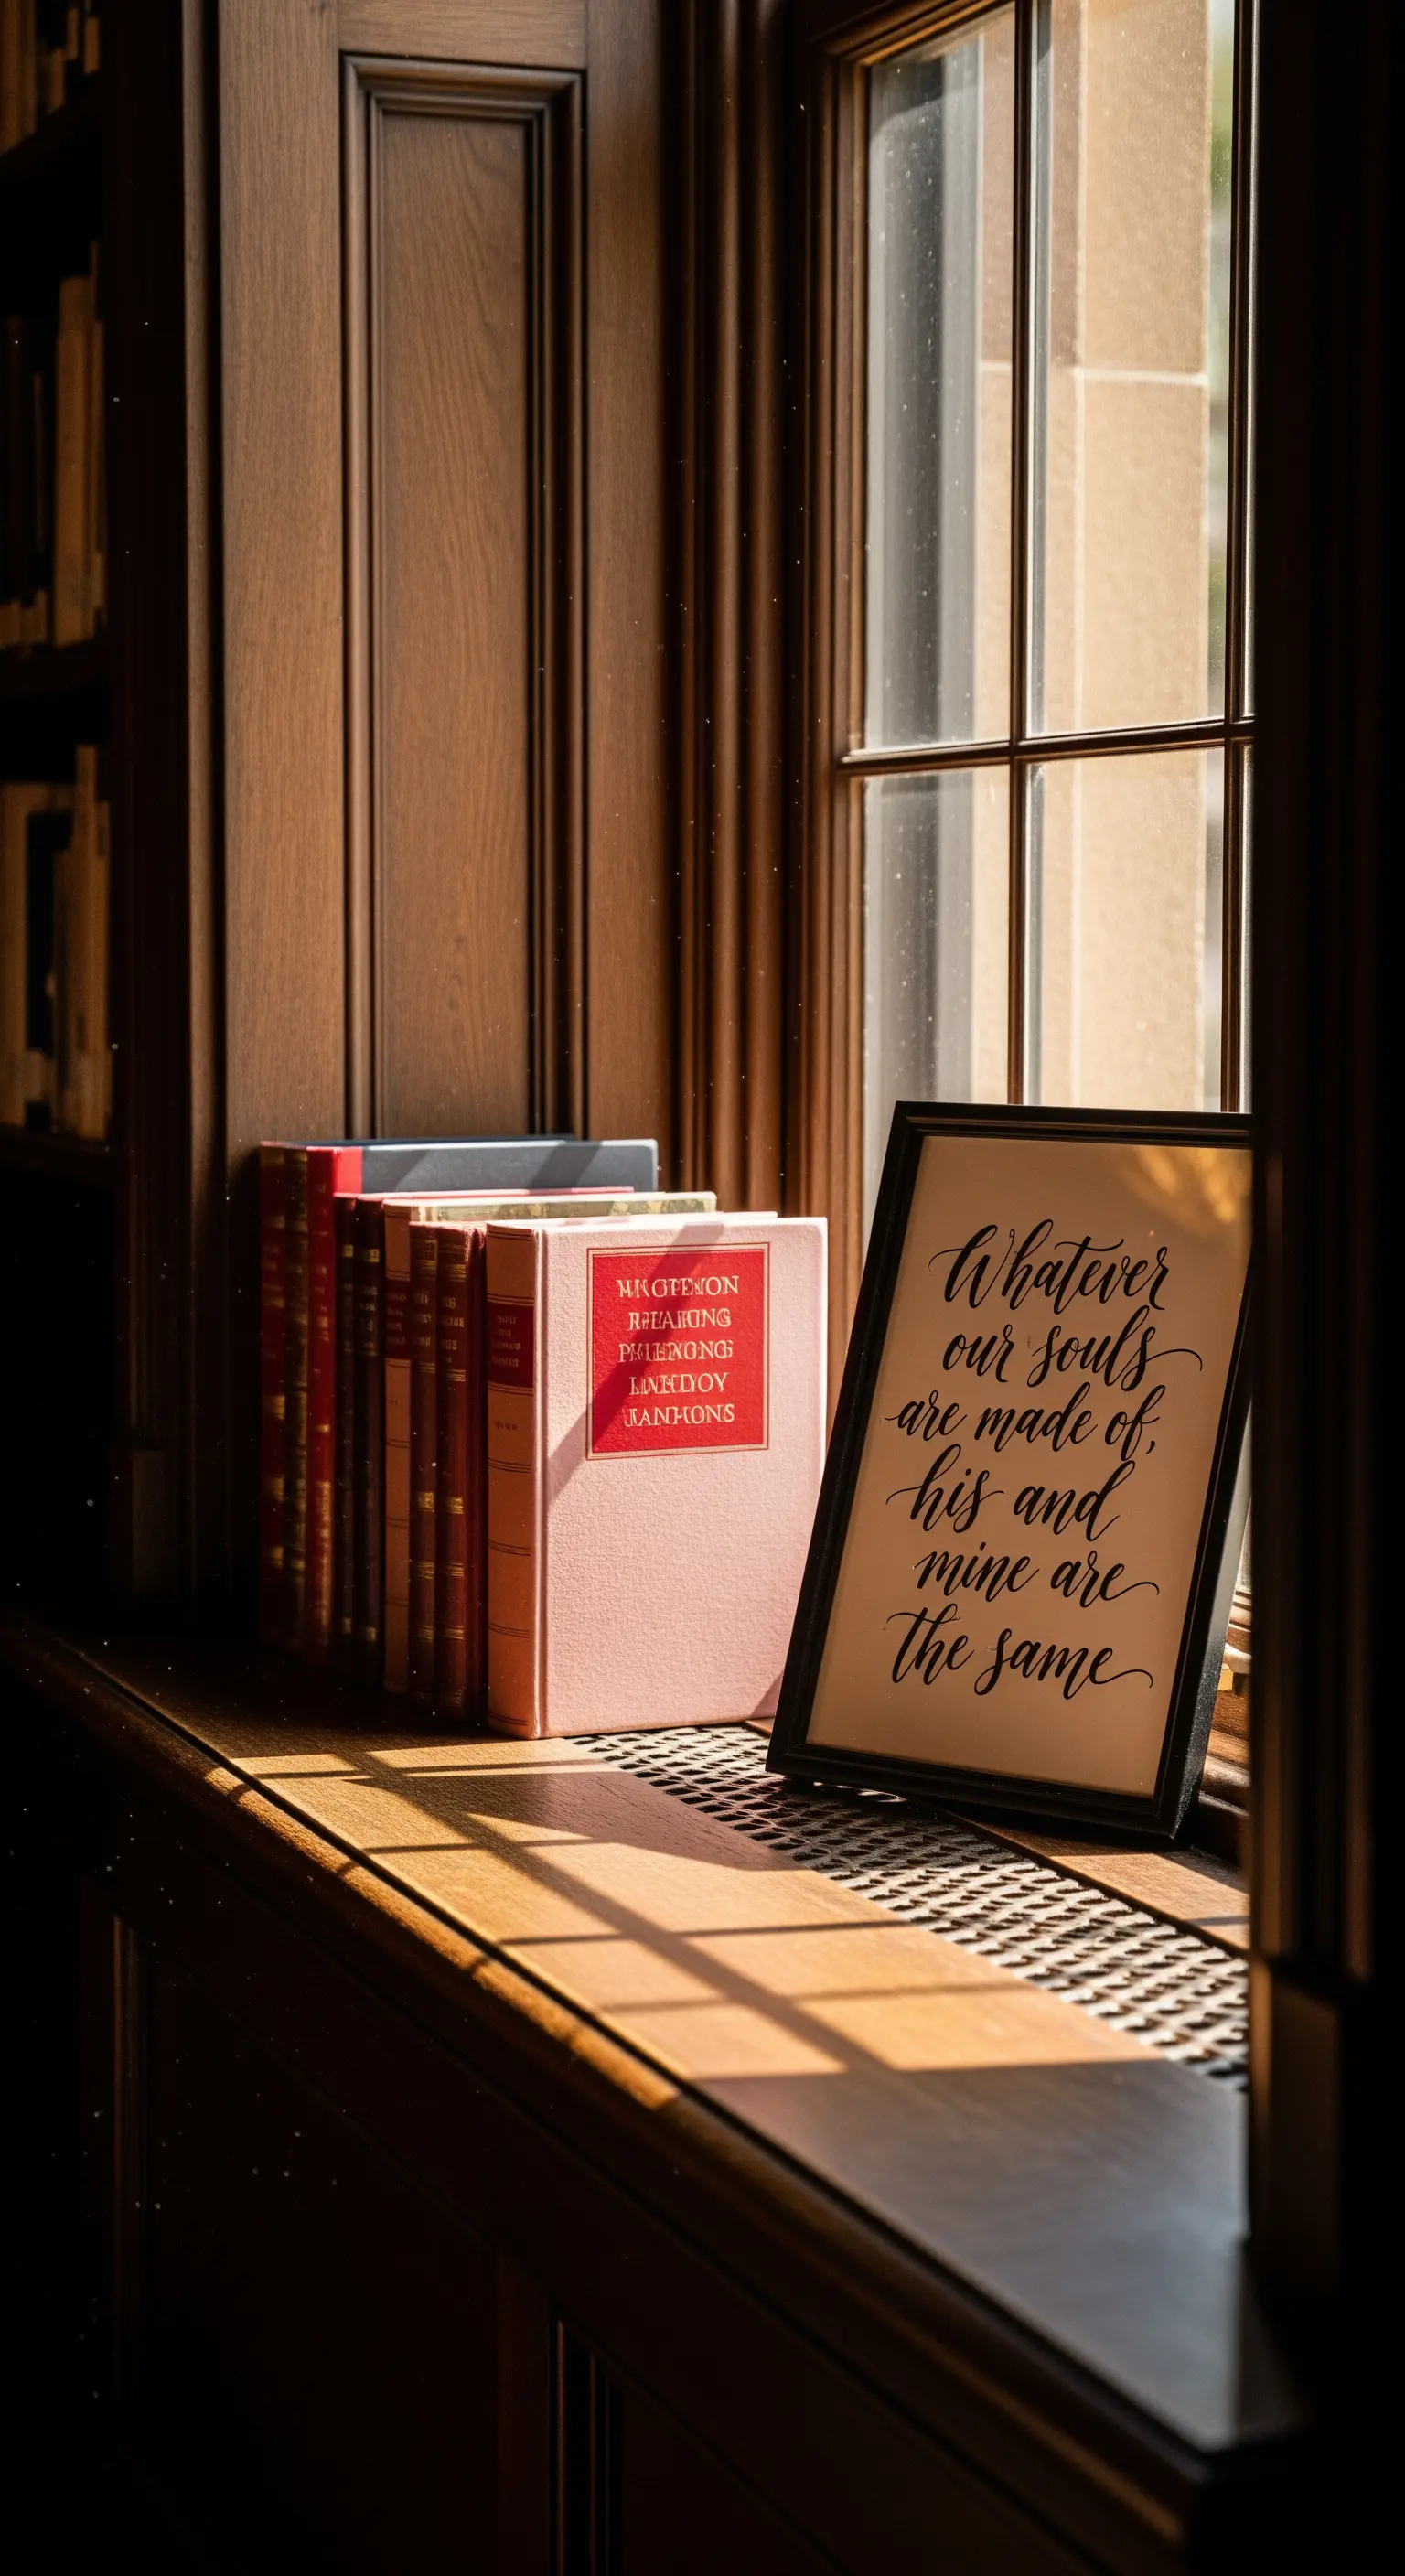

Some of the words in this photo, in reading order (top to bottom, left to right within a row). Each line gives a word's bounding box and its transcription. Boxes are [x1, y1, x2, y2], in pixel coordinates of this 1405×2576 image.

[928, 1218, 1170, 1315] Whatever
[942, 1323, 1016, 1383] our
[1026, 1304, 1203, 1392] souls
[884, 1390, 968, 1442] are
[973, 1381, 1099, 1453] made
[1104, 1384, 1166, 1462] of,
[885, 1443, 1005, 1533] his
[1013, 1459, 1136, 1542] and
[913, 1541, 1040, 1603] mine
[1050, 1550, 1160, 1608] are
[885, 1602, 975, 1686] the
[973, 1627, 1154, 1700] same
